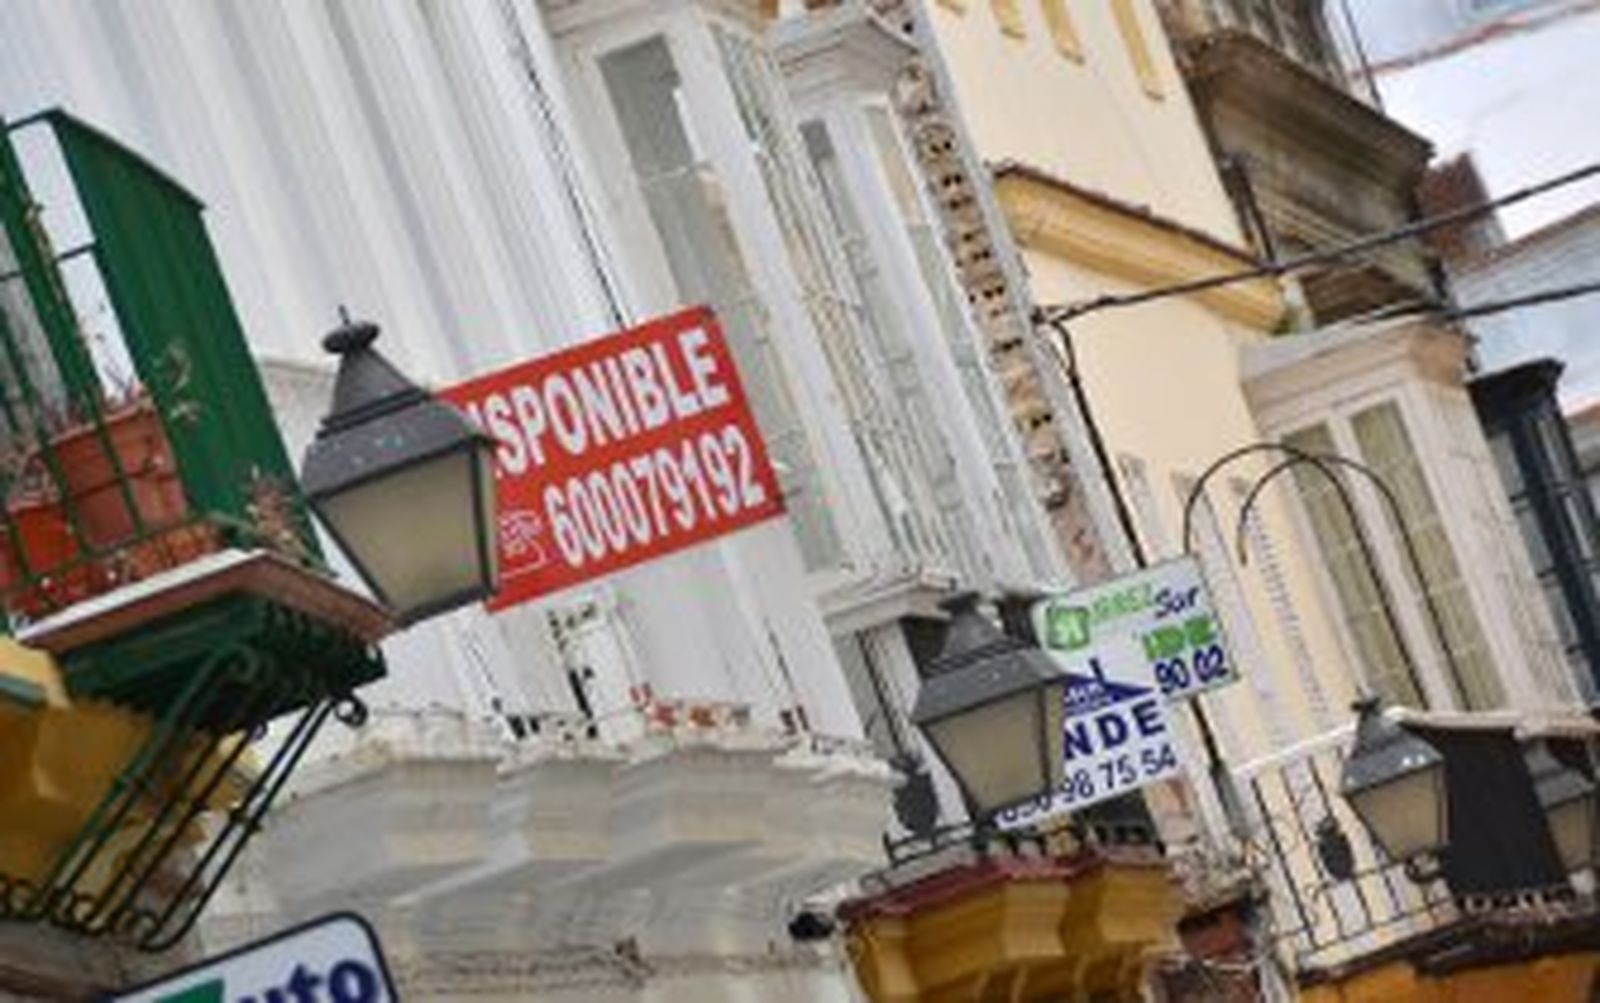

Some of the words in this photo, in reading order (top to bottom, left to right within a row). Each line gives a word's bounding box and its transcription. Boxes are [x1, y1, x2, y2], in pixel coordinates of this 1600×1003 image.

[543, 424, 766, 568] 600079192
[1063, 699, 1166, 760] NDE
[1098, 753, 1138, 787] 75
[1141, 743, 1178, 777] 54
